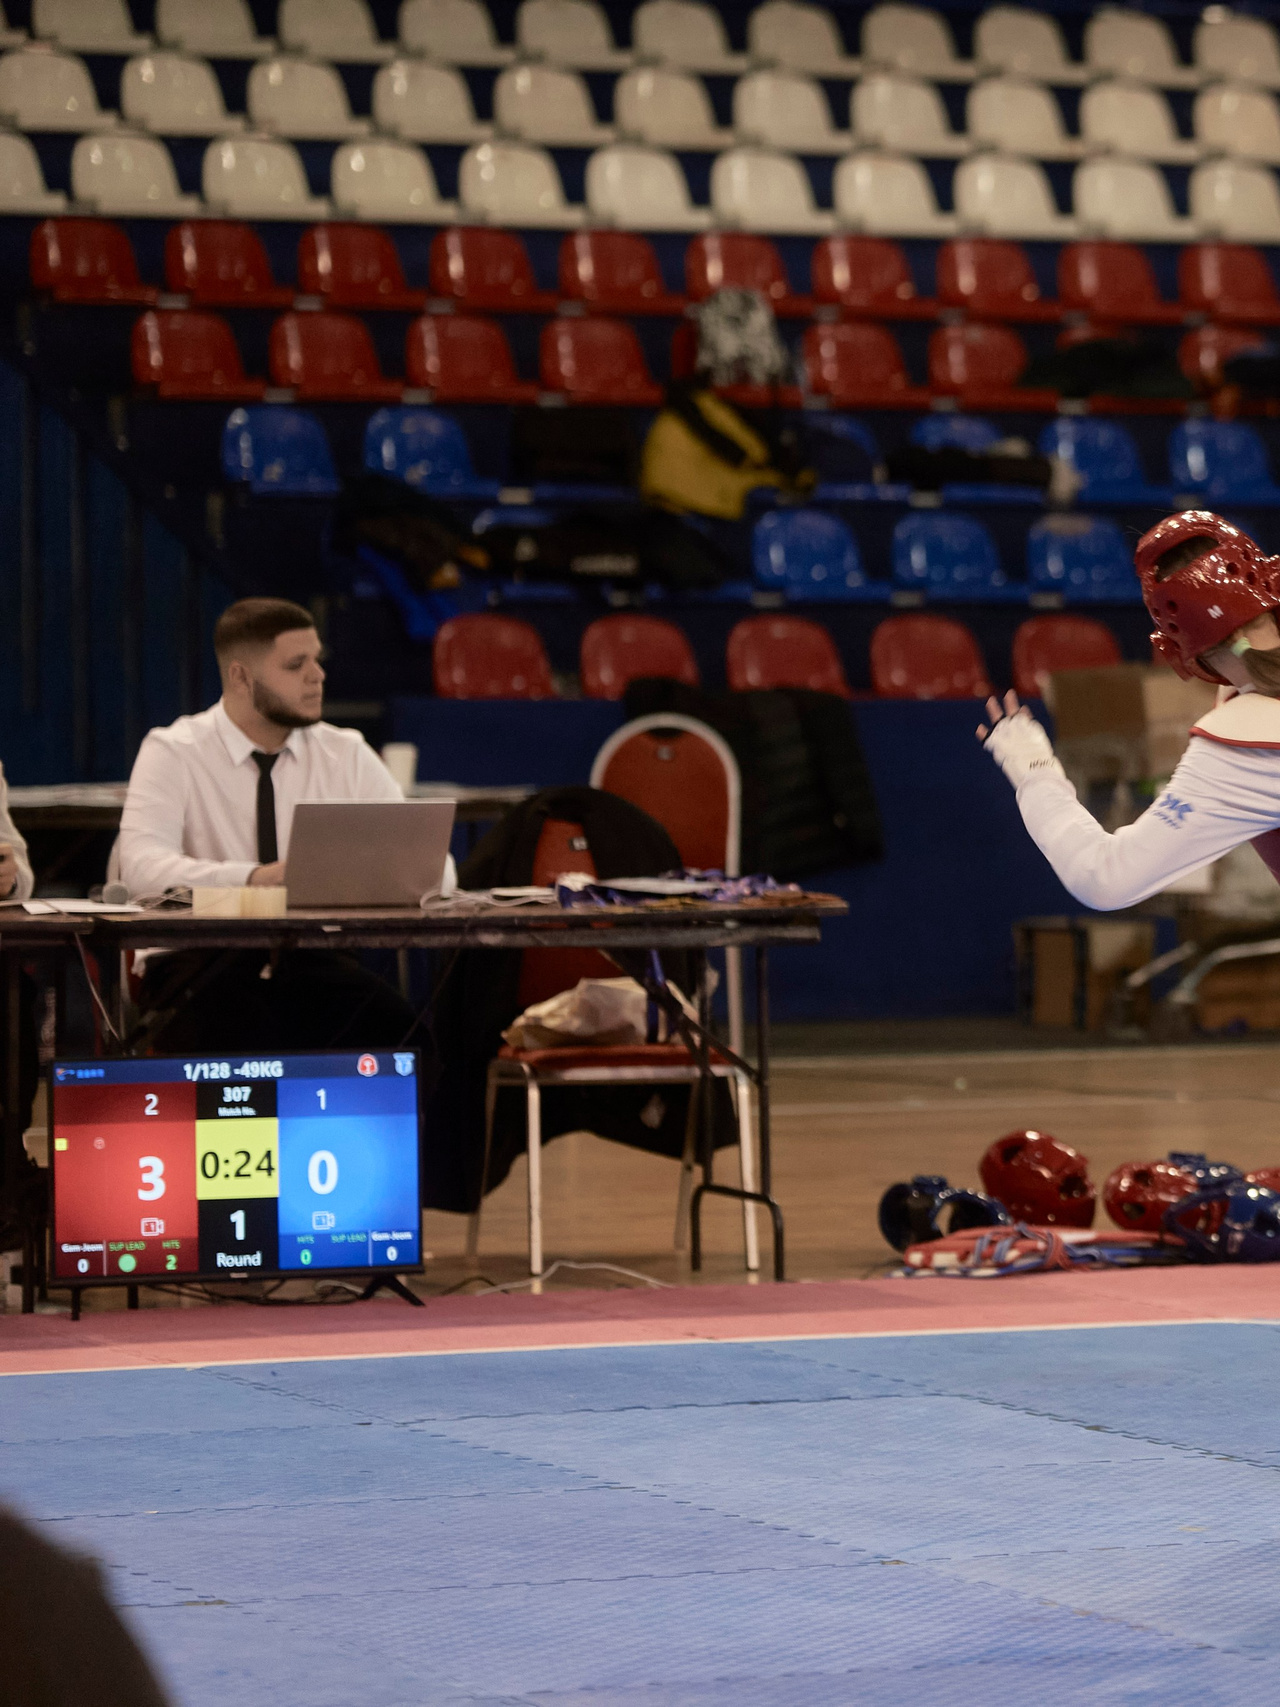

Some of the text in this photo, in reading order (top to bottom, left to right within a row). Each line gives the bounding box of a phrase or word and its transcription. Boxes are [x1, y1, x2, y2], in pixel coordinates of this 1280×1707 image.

[183, 1060, 284, 1082] 1/128 -49KG
[222, 1086, 252, 1103] 307
[316, 1088, 327, 1111] 1
[144, 1094, 159, 1116] 2
[217, 1107, 242, 1117] Match
[201, 1150, 276, 1179] 0:24
[307, 1149, 339, 1195] 0
[137, 1155, 167, 1201] 3
[229, 1209, 246, 1241] 1
[162, 1240, 180, 1250] HITS
[165, 1254, 178, 1271] 2
[216, 1251, 262, 1268] Round
[300, 1249, 312, 1266] 0
[386, 1246, 398, 1262] 0
[77, 1258, 90, 1273] 0
